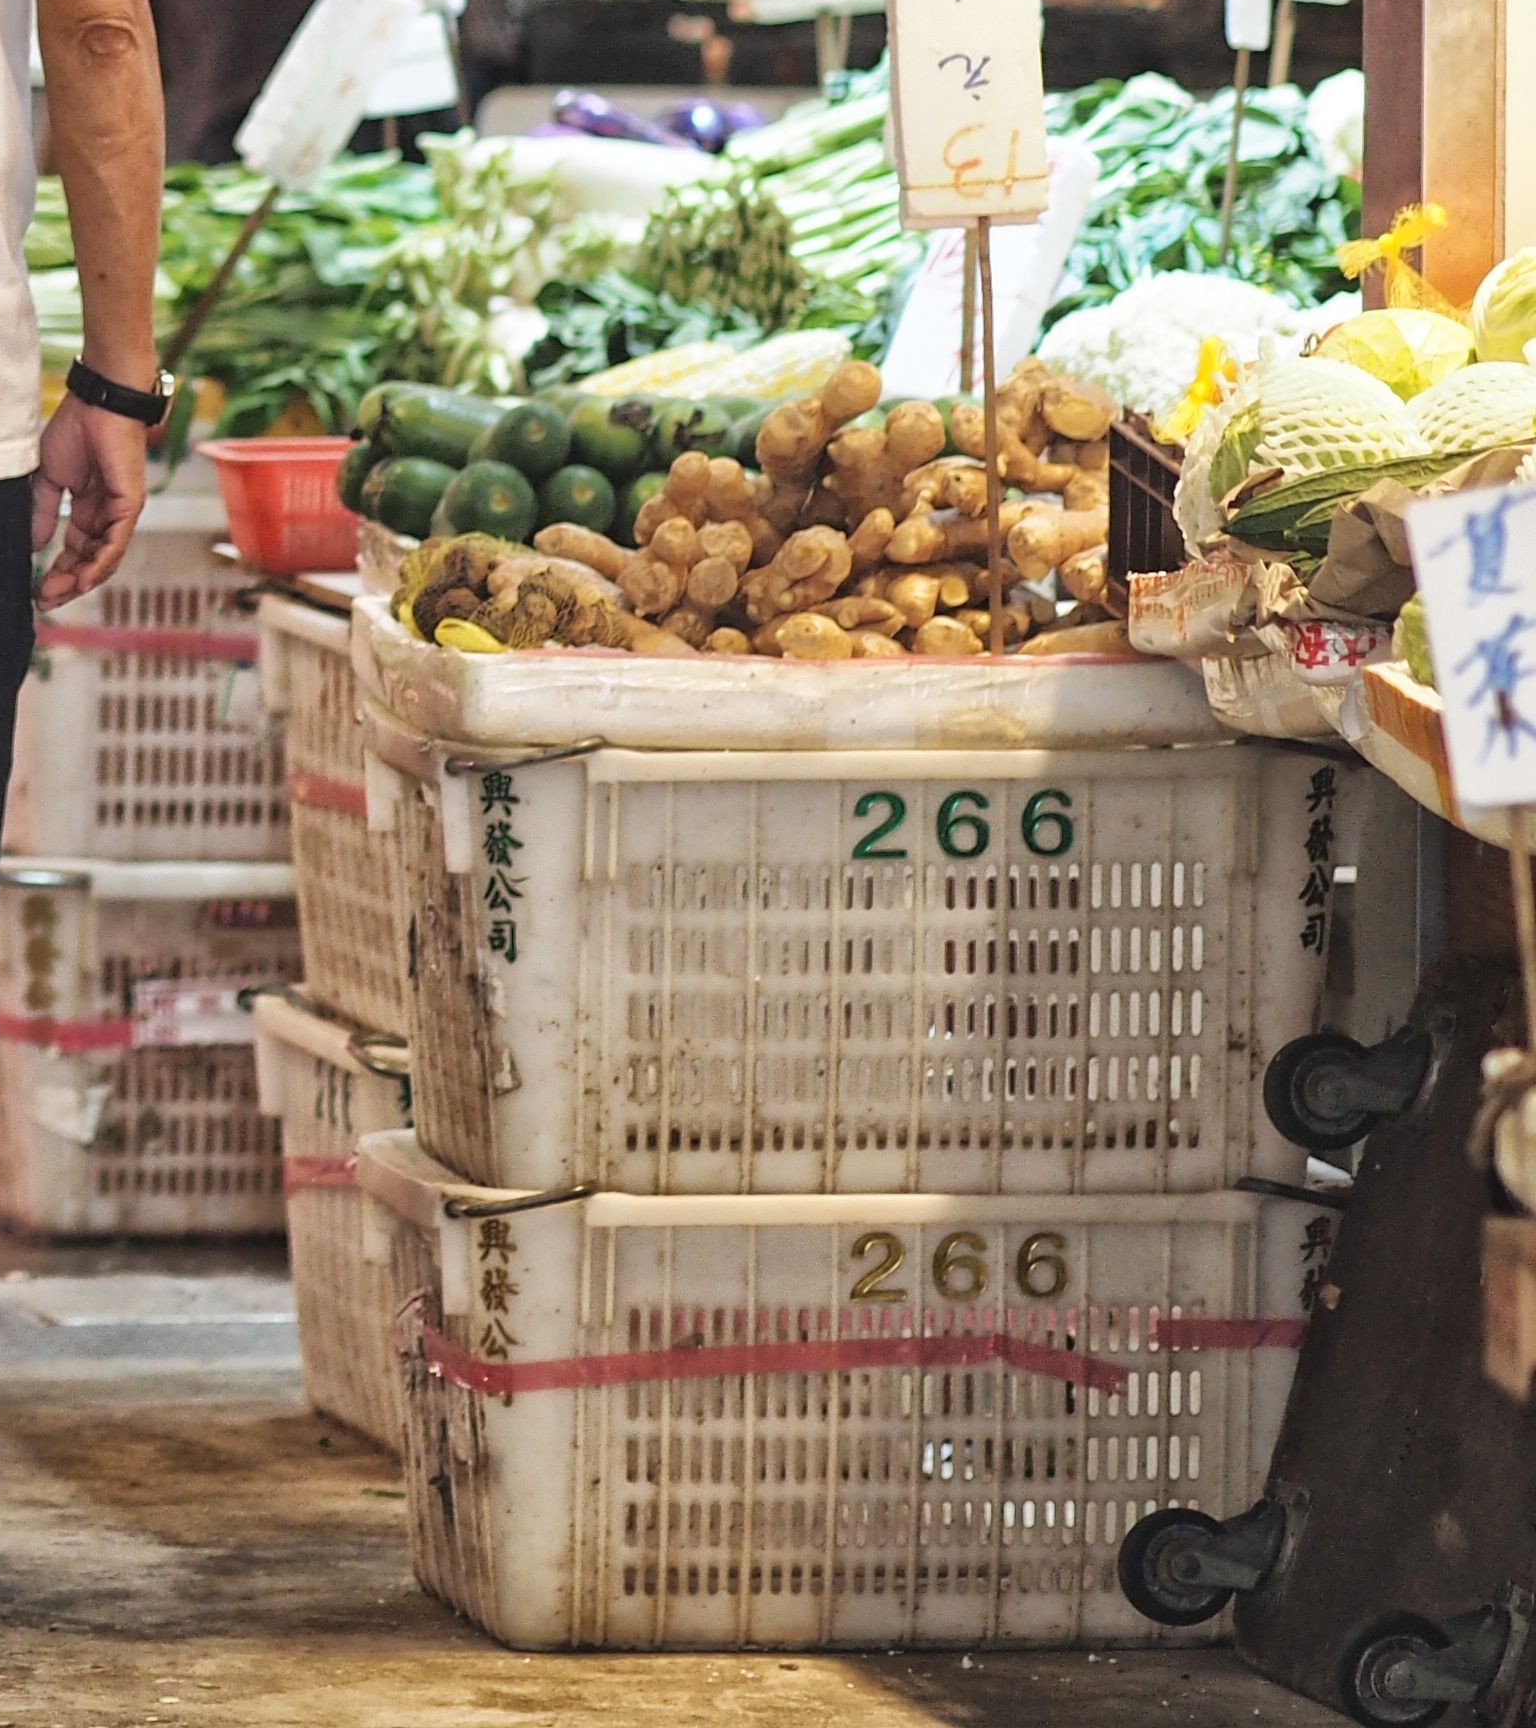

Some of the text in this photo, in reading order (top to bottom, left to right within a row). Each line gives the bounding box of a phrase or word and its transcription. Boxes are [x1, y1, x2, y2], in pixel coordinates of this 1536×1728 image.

[479, 771, 525, 964] 興發公司
[851, 788, 1075, 860] 266
[1298, 765, 1336, 956] 興發公司
[477, 1218, 520, 1407] 興發公
[848, 1230, 1068, 1303] 266
